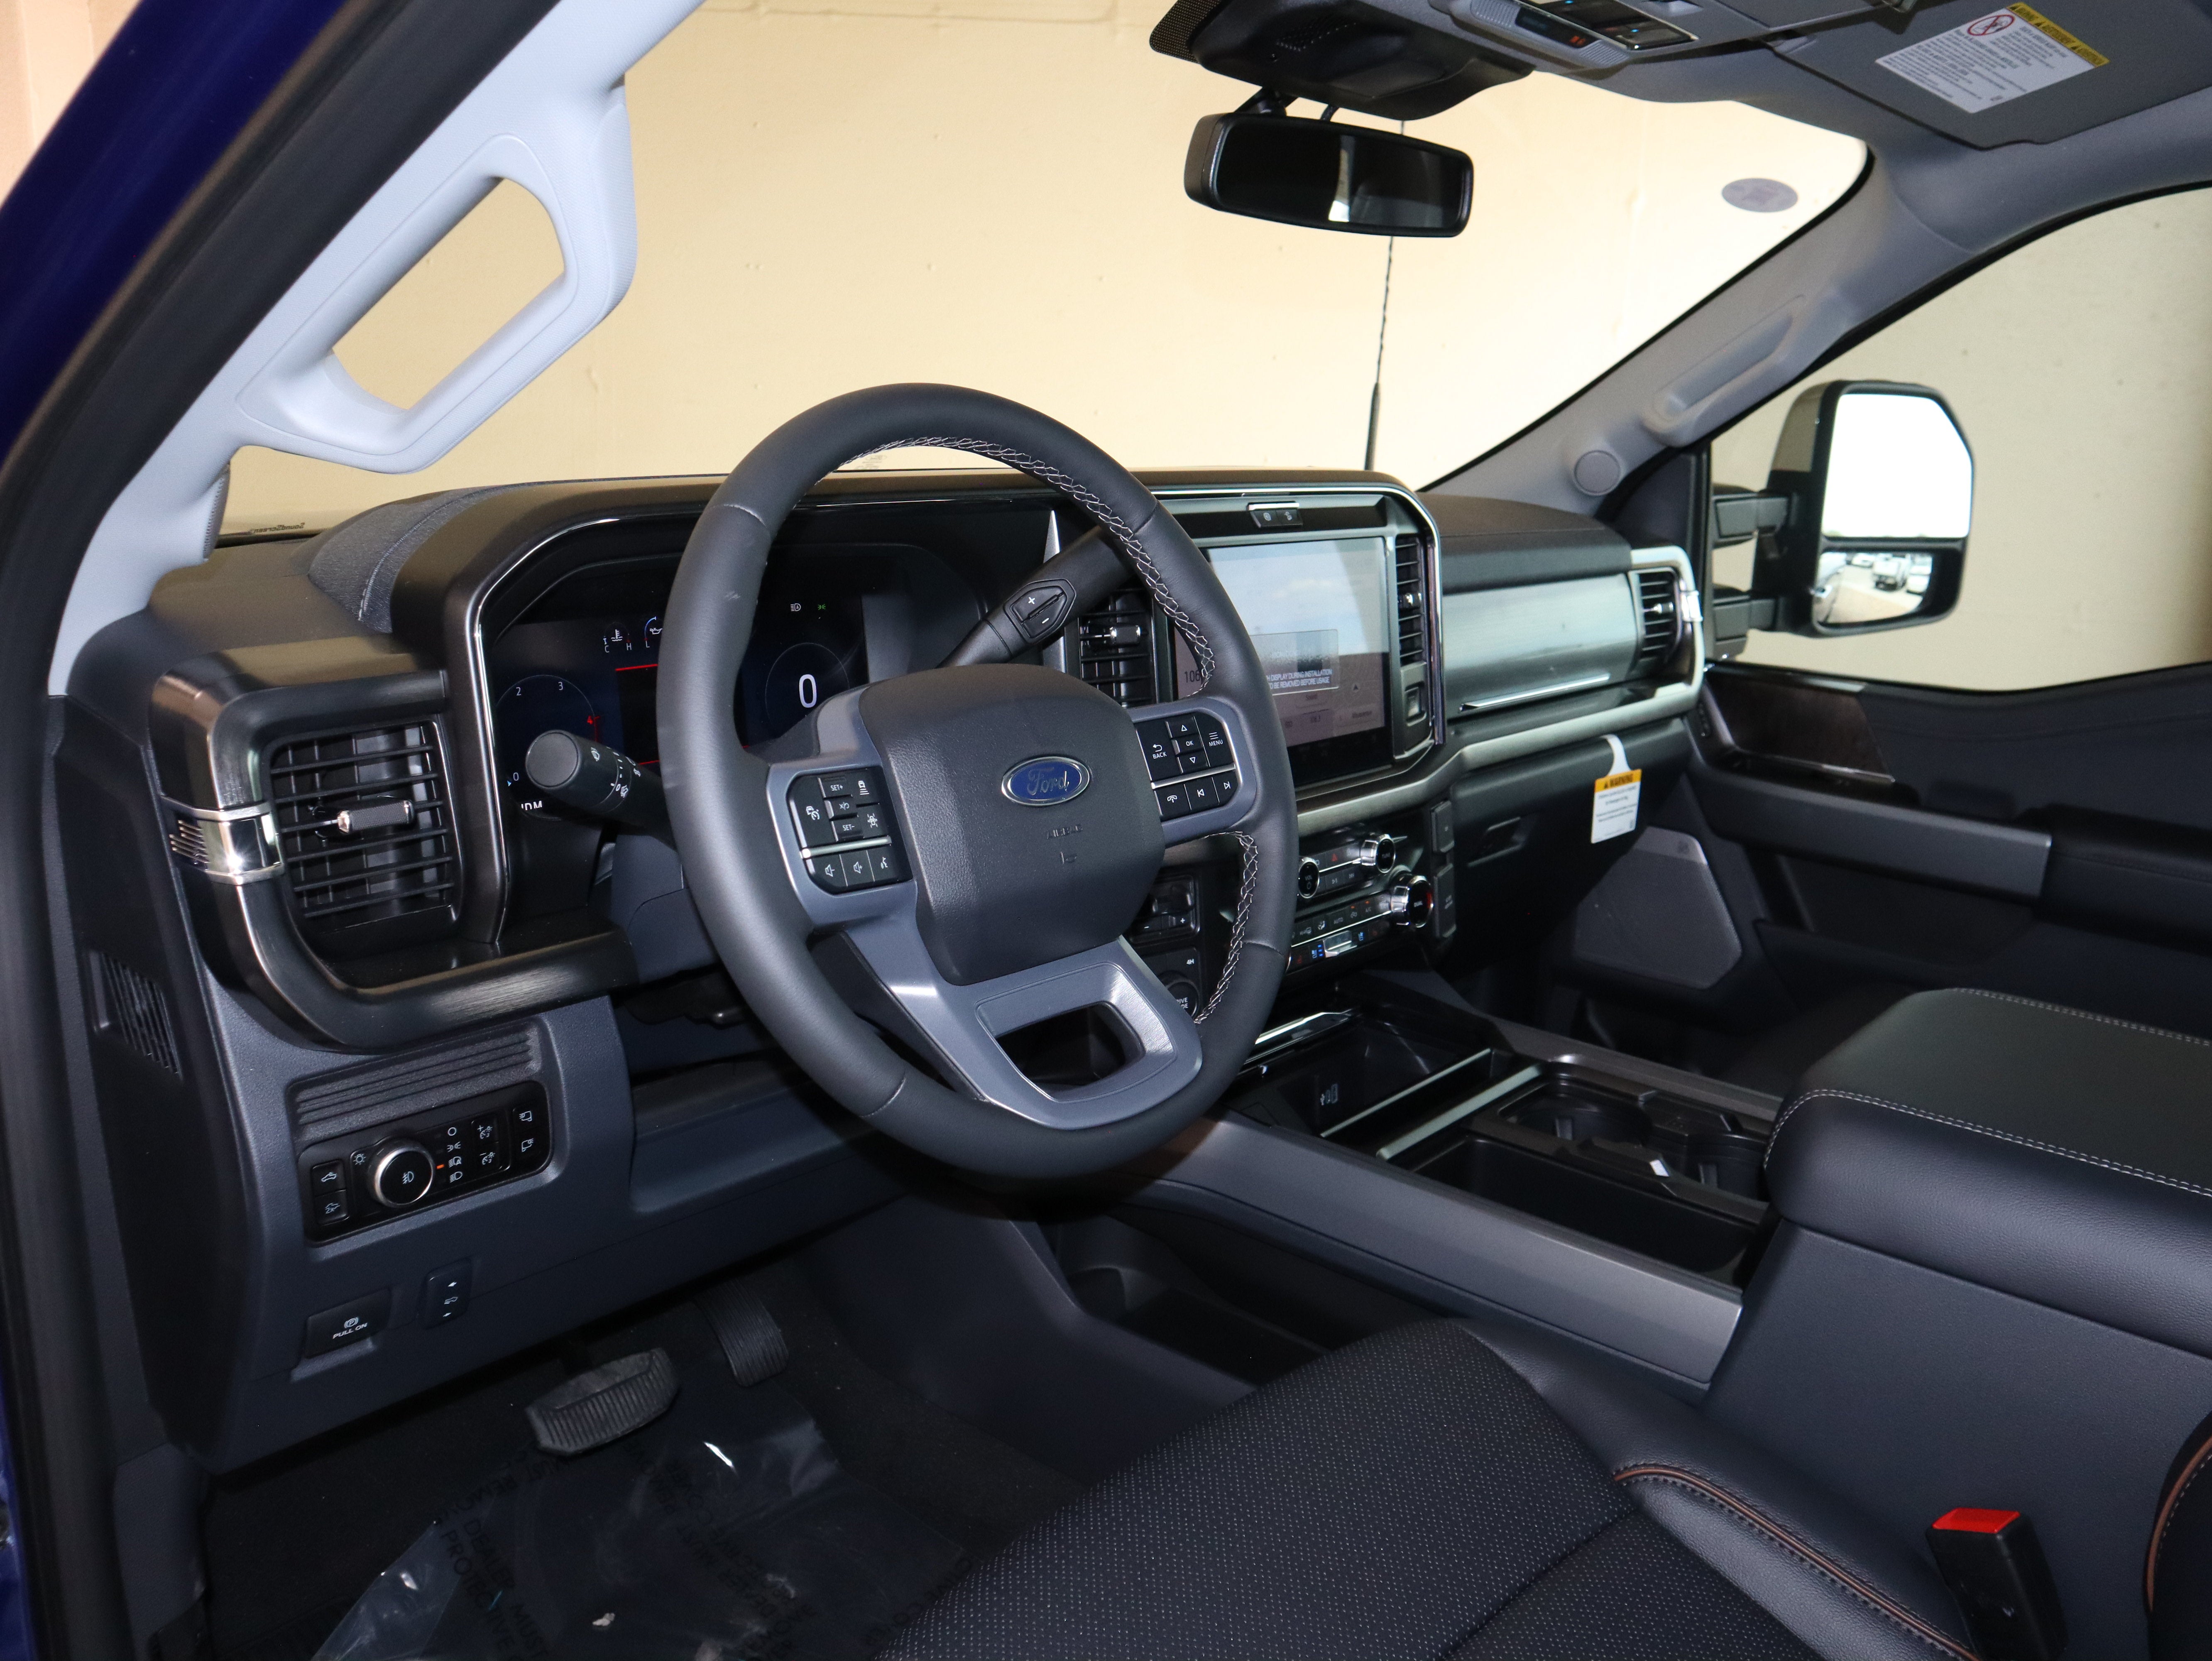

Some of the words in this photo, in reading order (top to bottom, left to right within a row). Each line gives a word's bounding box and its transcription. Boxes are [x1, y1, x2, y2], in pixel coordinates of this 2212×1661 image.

[558, 681, 563, 691] 3
[798, 674, 817, 708] 0
[516, 687, 521, 696] 2
[587, 715, 593, 725] 4
[513, 772, 519, 781] 0
[1027, 767, 1069, 796] Ford
[333, 1328, 355, 1339] PULL
[355, 1323, 368, 1331] ON
